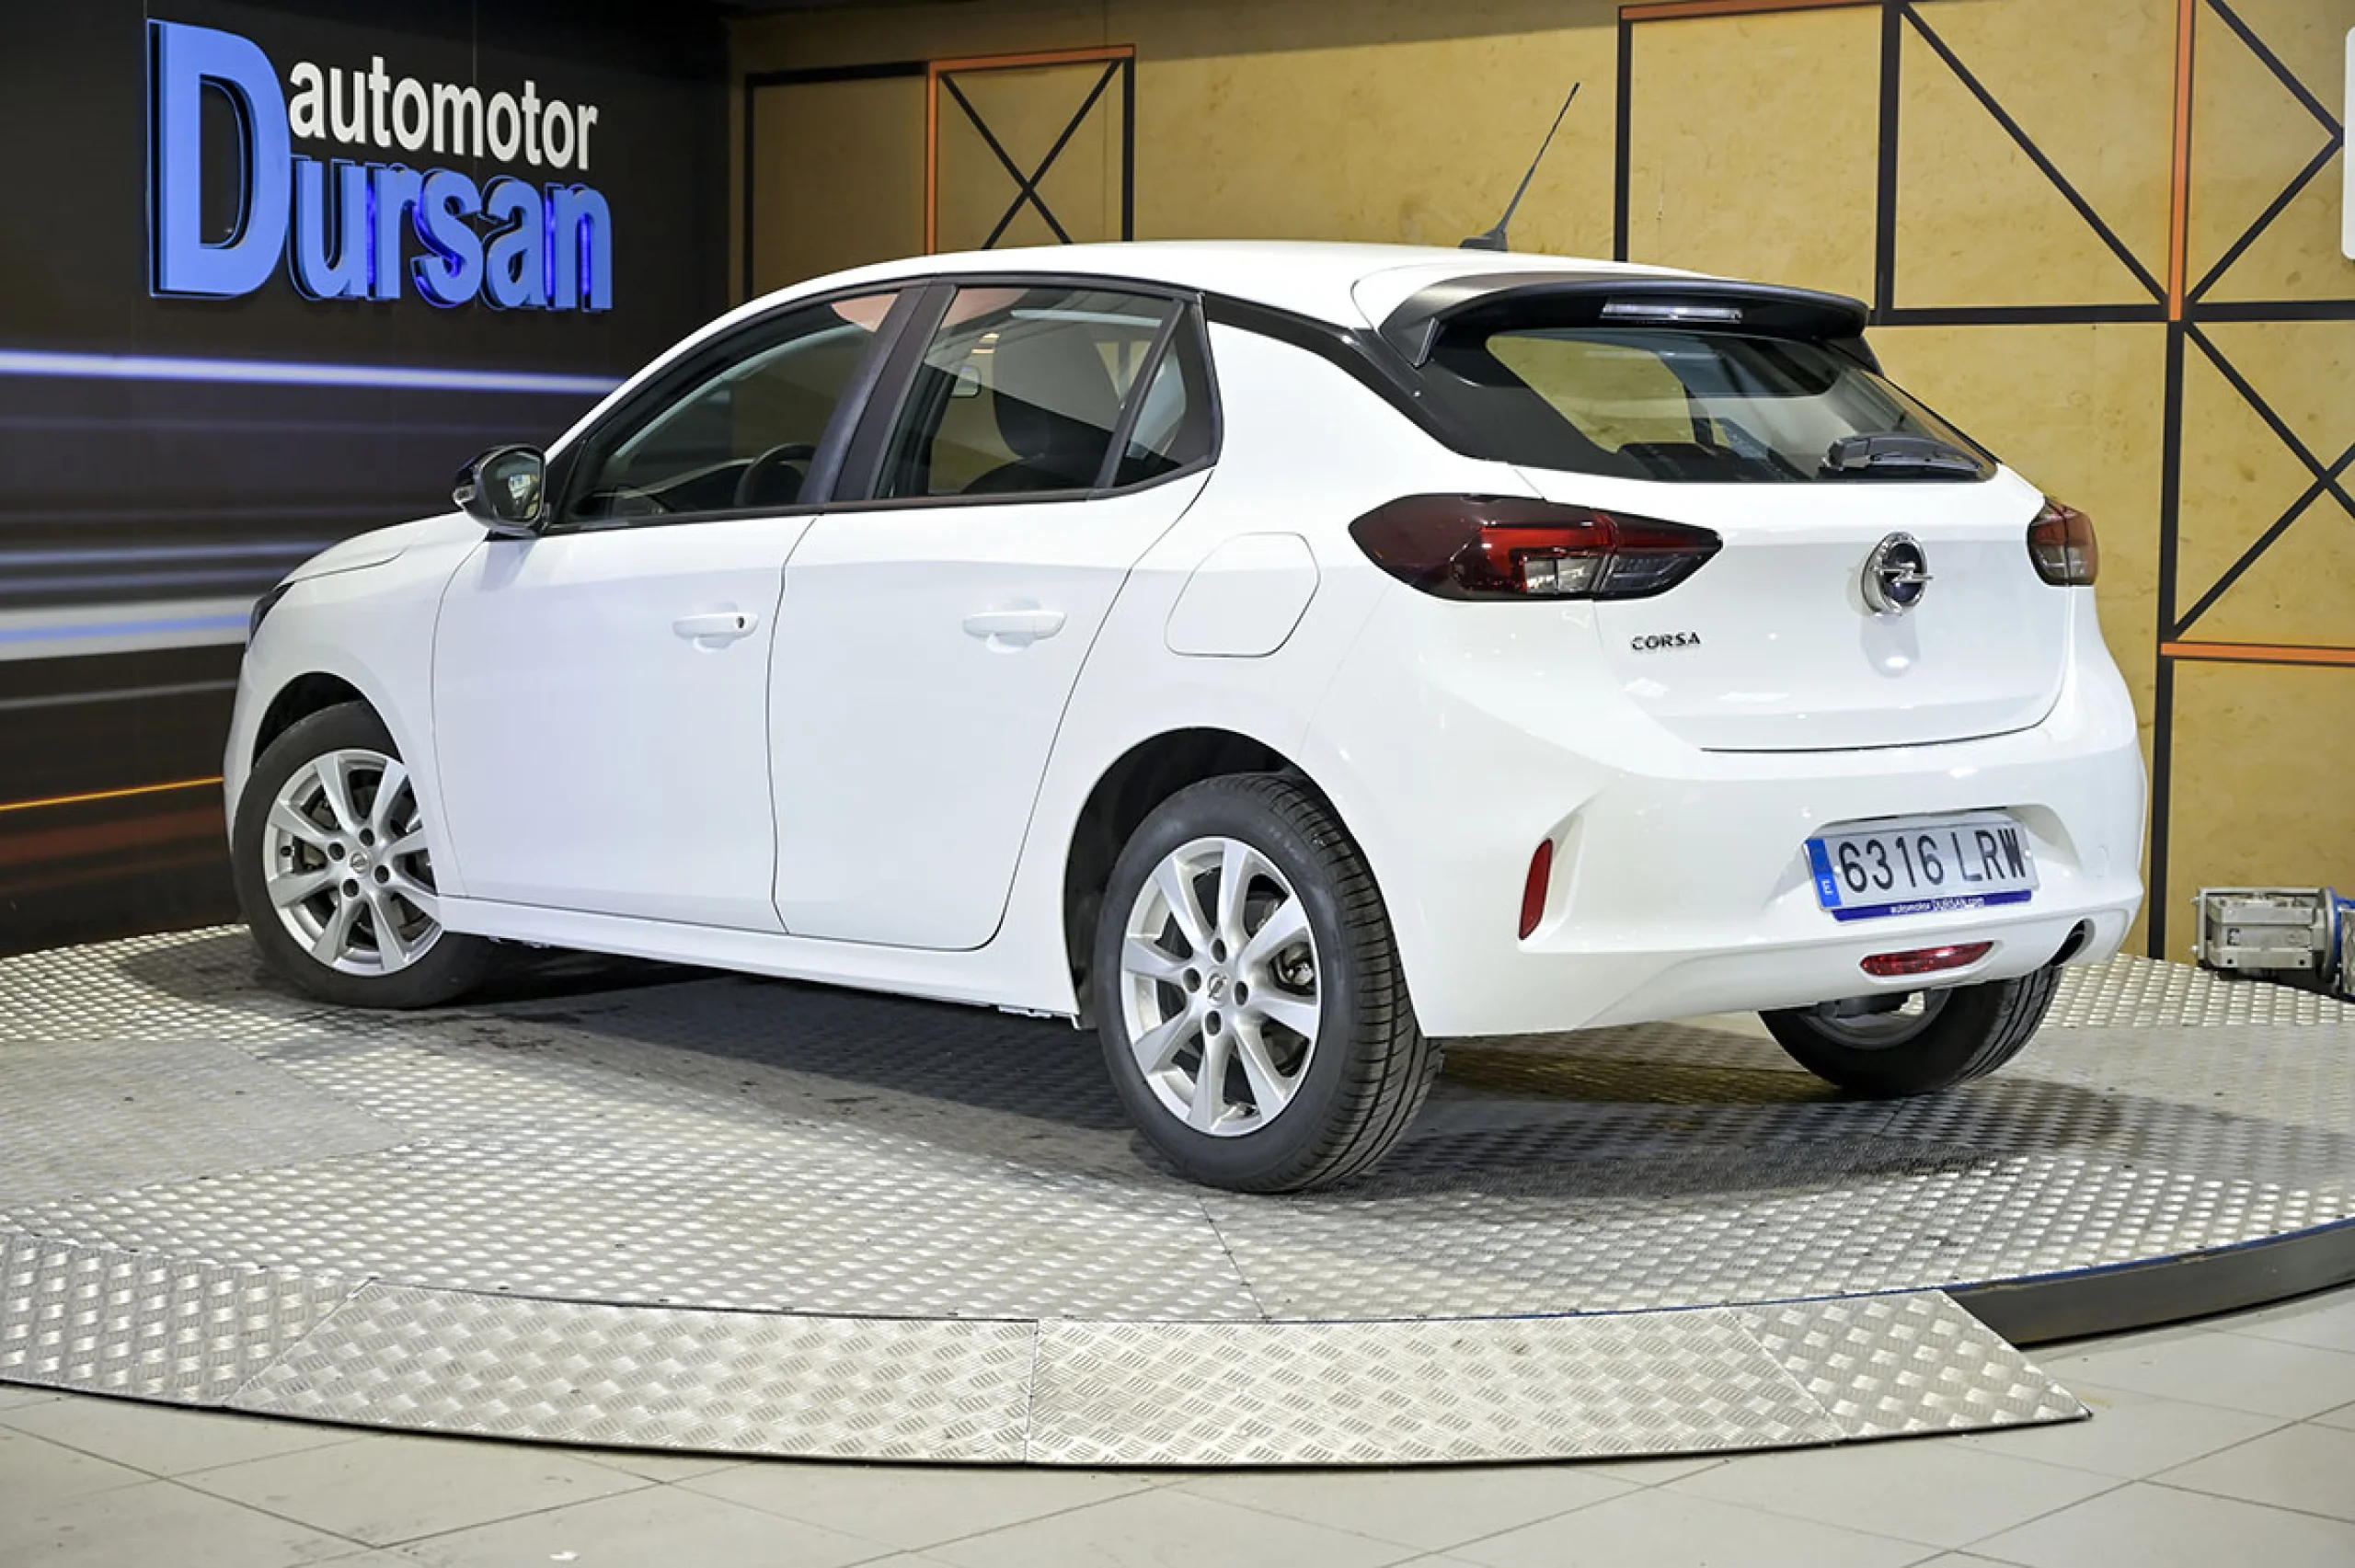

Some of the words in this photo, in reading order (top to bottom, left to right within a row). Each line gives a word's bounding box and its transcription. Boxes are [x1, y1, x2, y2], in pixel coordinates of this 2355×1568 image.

[289, 55, 599, 171] automotor
[147, 18, 614, 311] Dursan
[1631, 631, 1701, 650] CORSA
[1821, 879, 1834, 896] E
[1838, 835, 1946, 894] 6316
[1950, 827, 2026, 882] LRW
